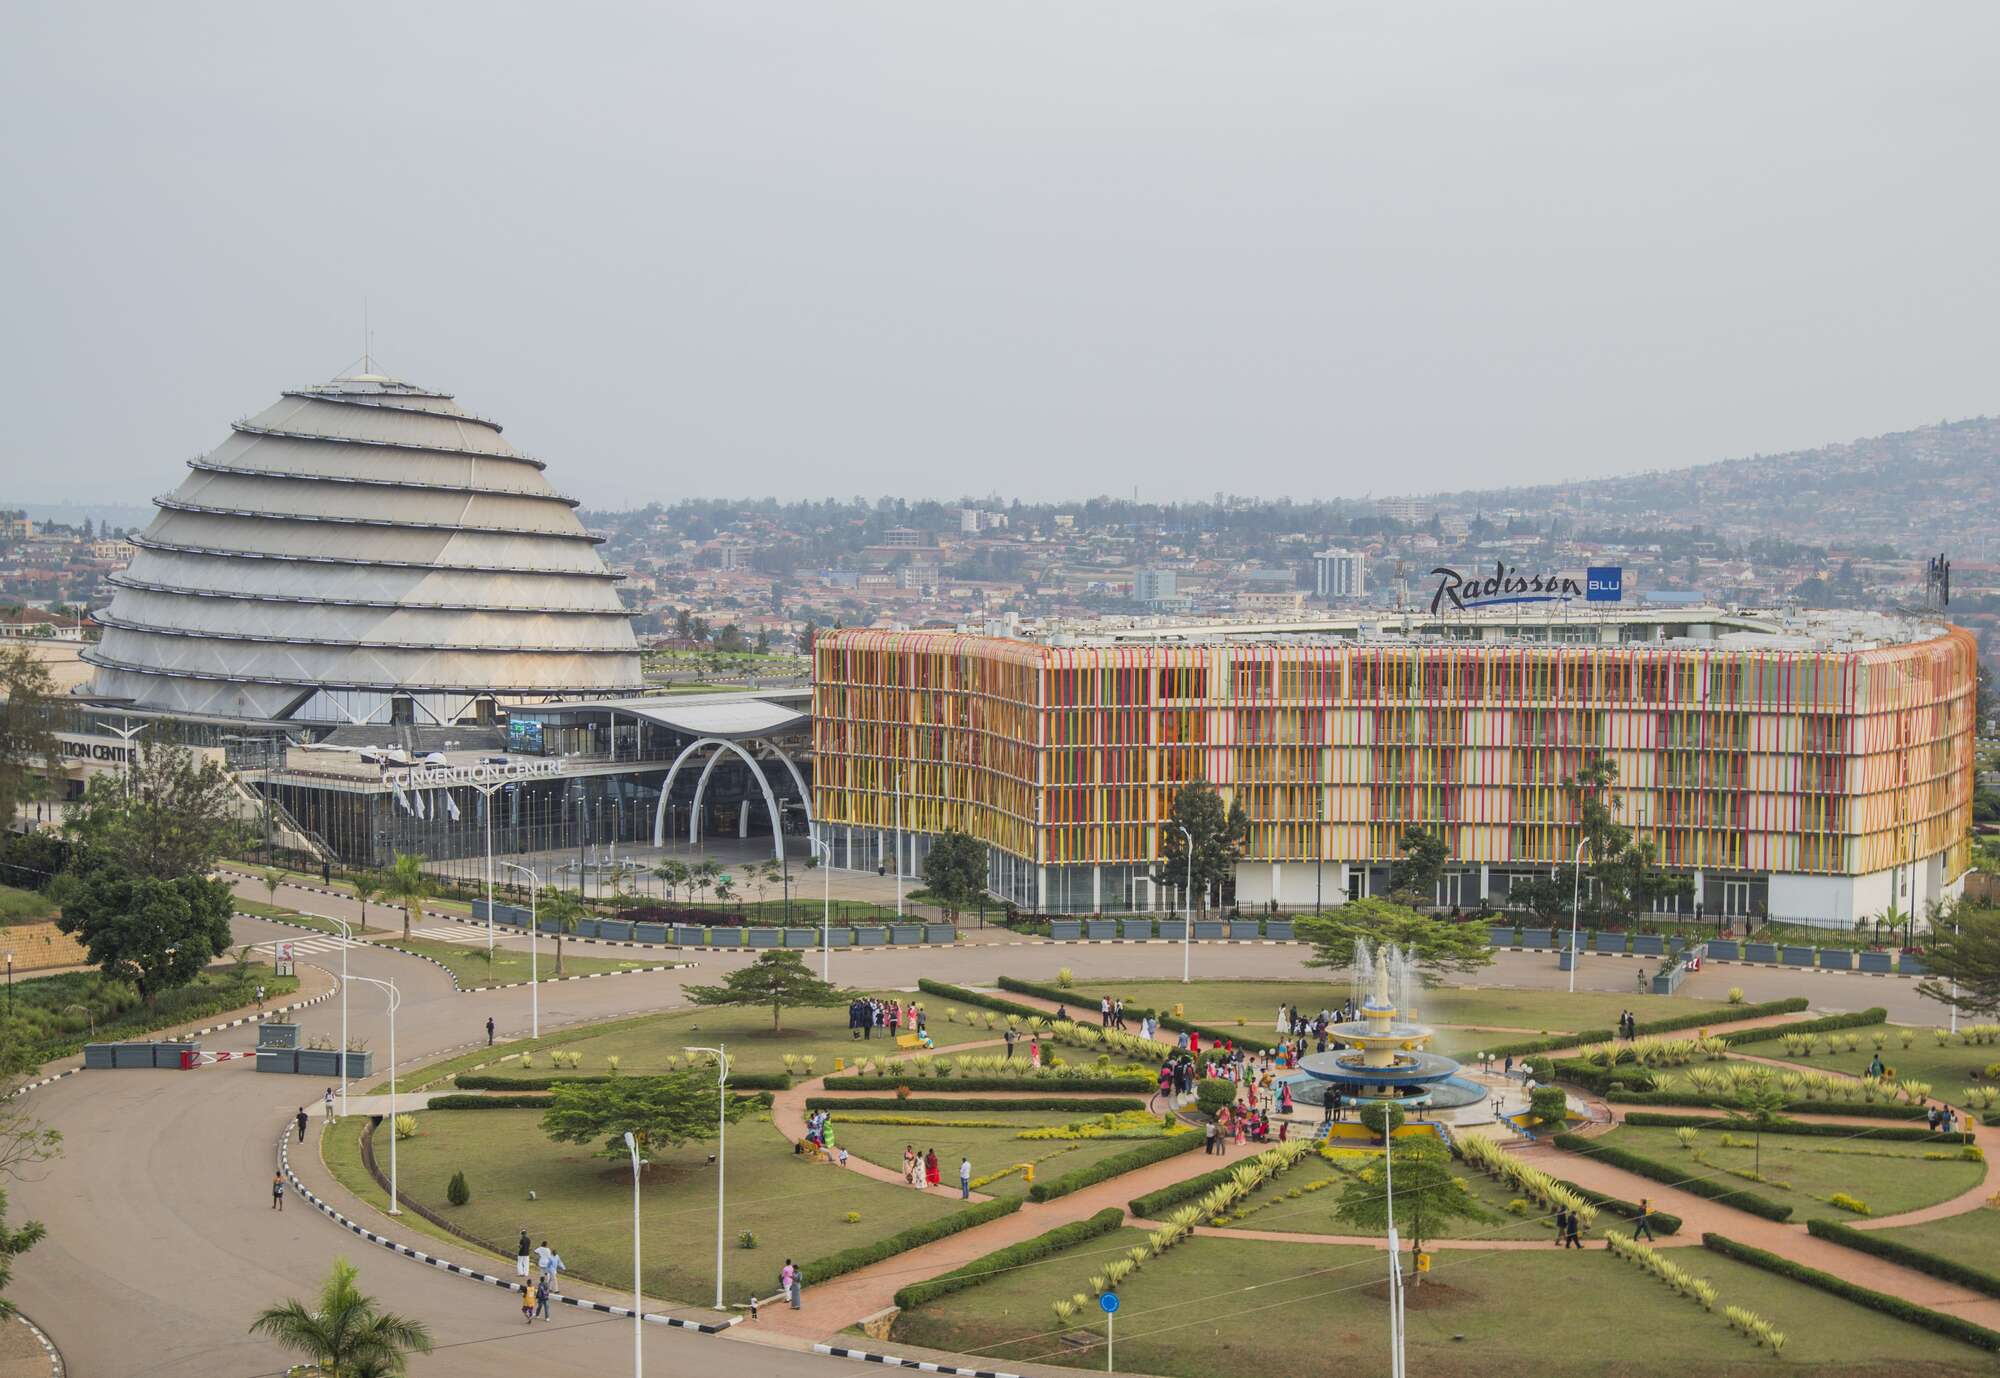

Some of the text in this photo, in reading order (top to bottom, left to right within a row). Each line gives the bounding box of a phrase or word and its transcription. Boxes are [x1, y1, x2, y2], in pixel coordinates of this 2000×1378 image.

[1431, 561, 1620, 616] Radisson BLU
[382, 760, 566, 787] CONVENTION CENTRE
